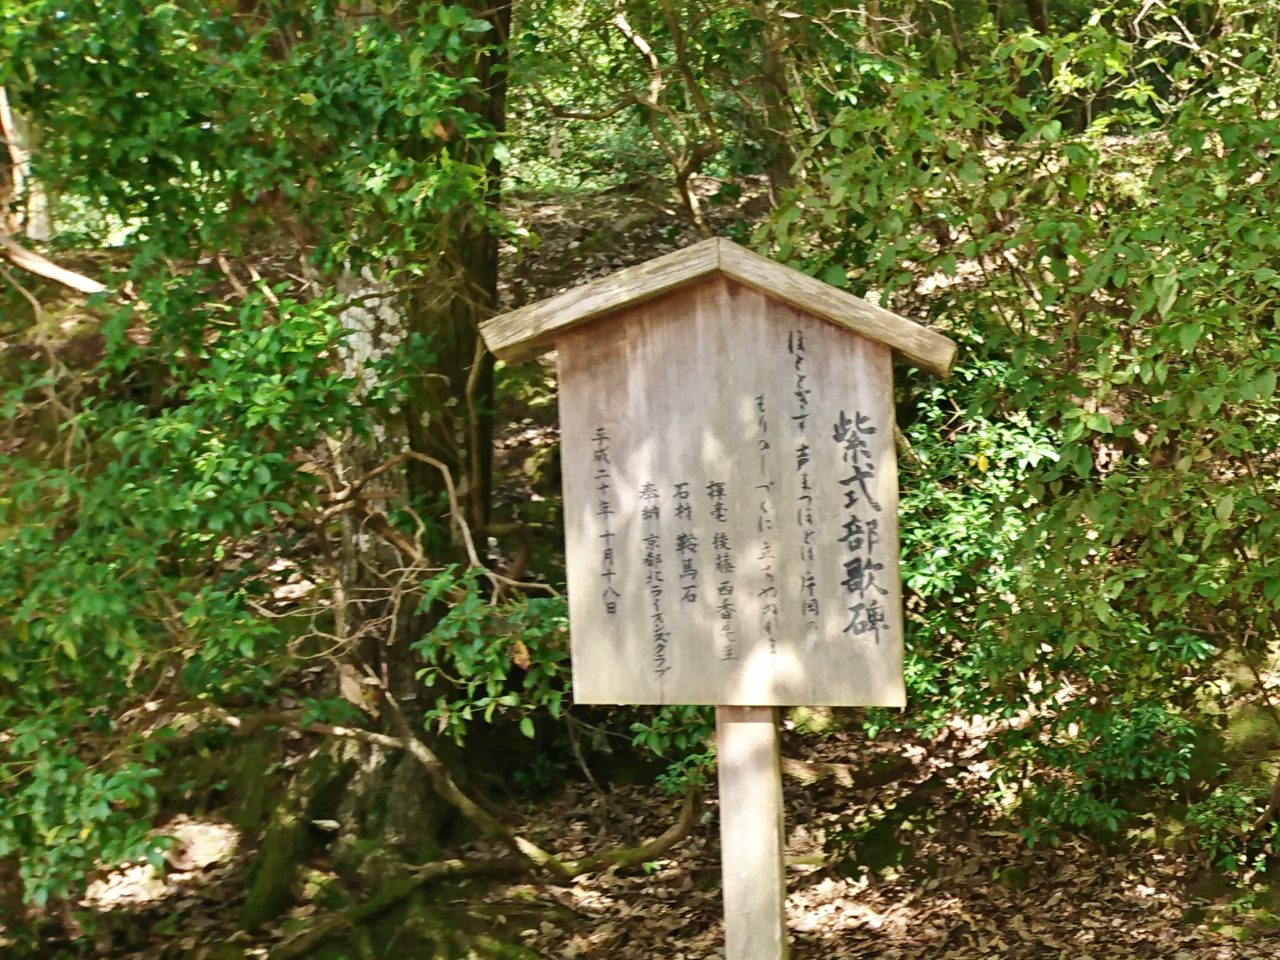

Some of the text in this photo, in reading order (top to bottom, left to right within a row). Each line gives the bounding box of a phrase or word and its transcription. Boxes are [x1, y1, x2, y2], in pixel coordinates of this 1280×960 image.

[639, 482, 672, 680] 奉納 京都北ライオンズクラブ
[673, 483, 699, 603] 石材 鞍馬石
[704, 480, 727, 523] 揮毫
[833, 408, 890, 646] 紫式部歌碑
